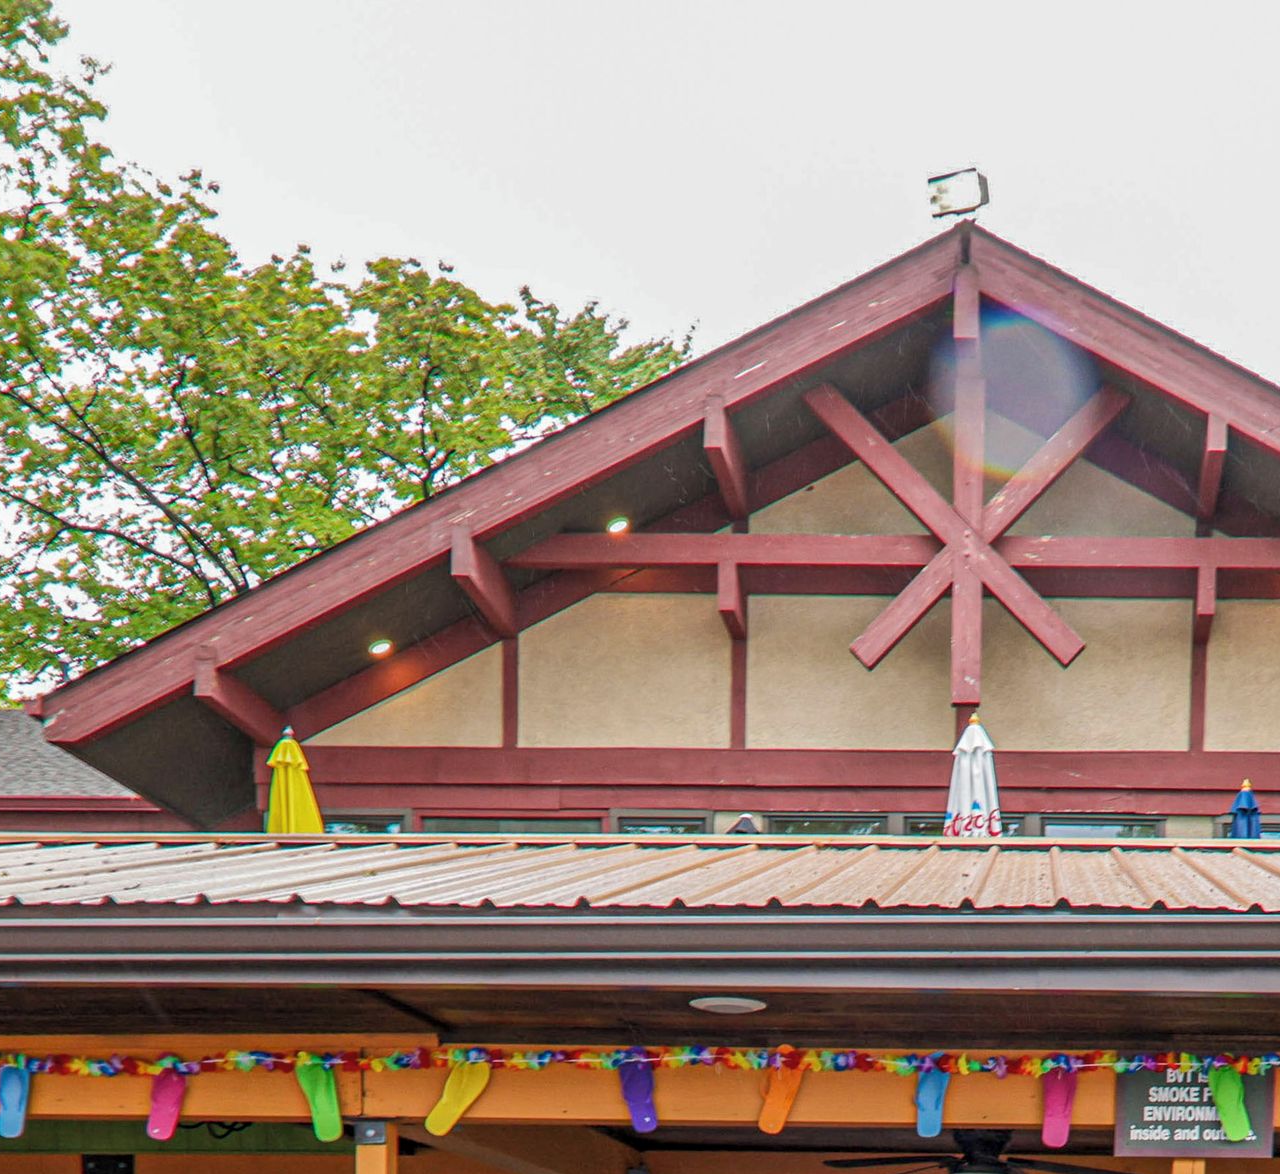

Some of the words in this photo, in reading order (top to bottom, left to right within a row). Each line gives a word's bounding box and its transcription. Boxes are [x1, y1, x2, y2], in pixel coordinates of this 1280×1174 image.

[1148, 1086, 1200, 1103] SMOKE
[1143, 1105, 1222, 1121] ENVIRONM
[1130, 1124, 1171, 1141] inside
[1173, 1124, 1200, 1141] and
[1202, 1124, 1257, 1141] oute.
